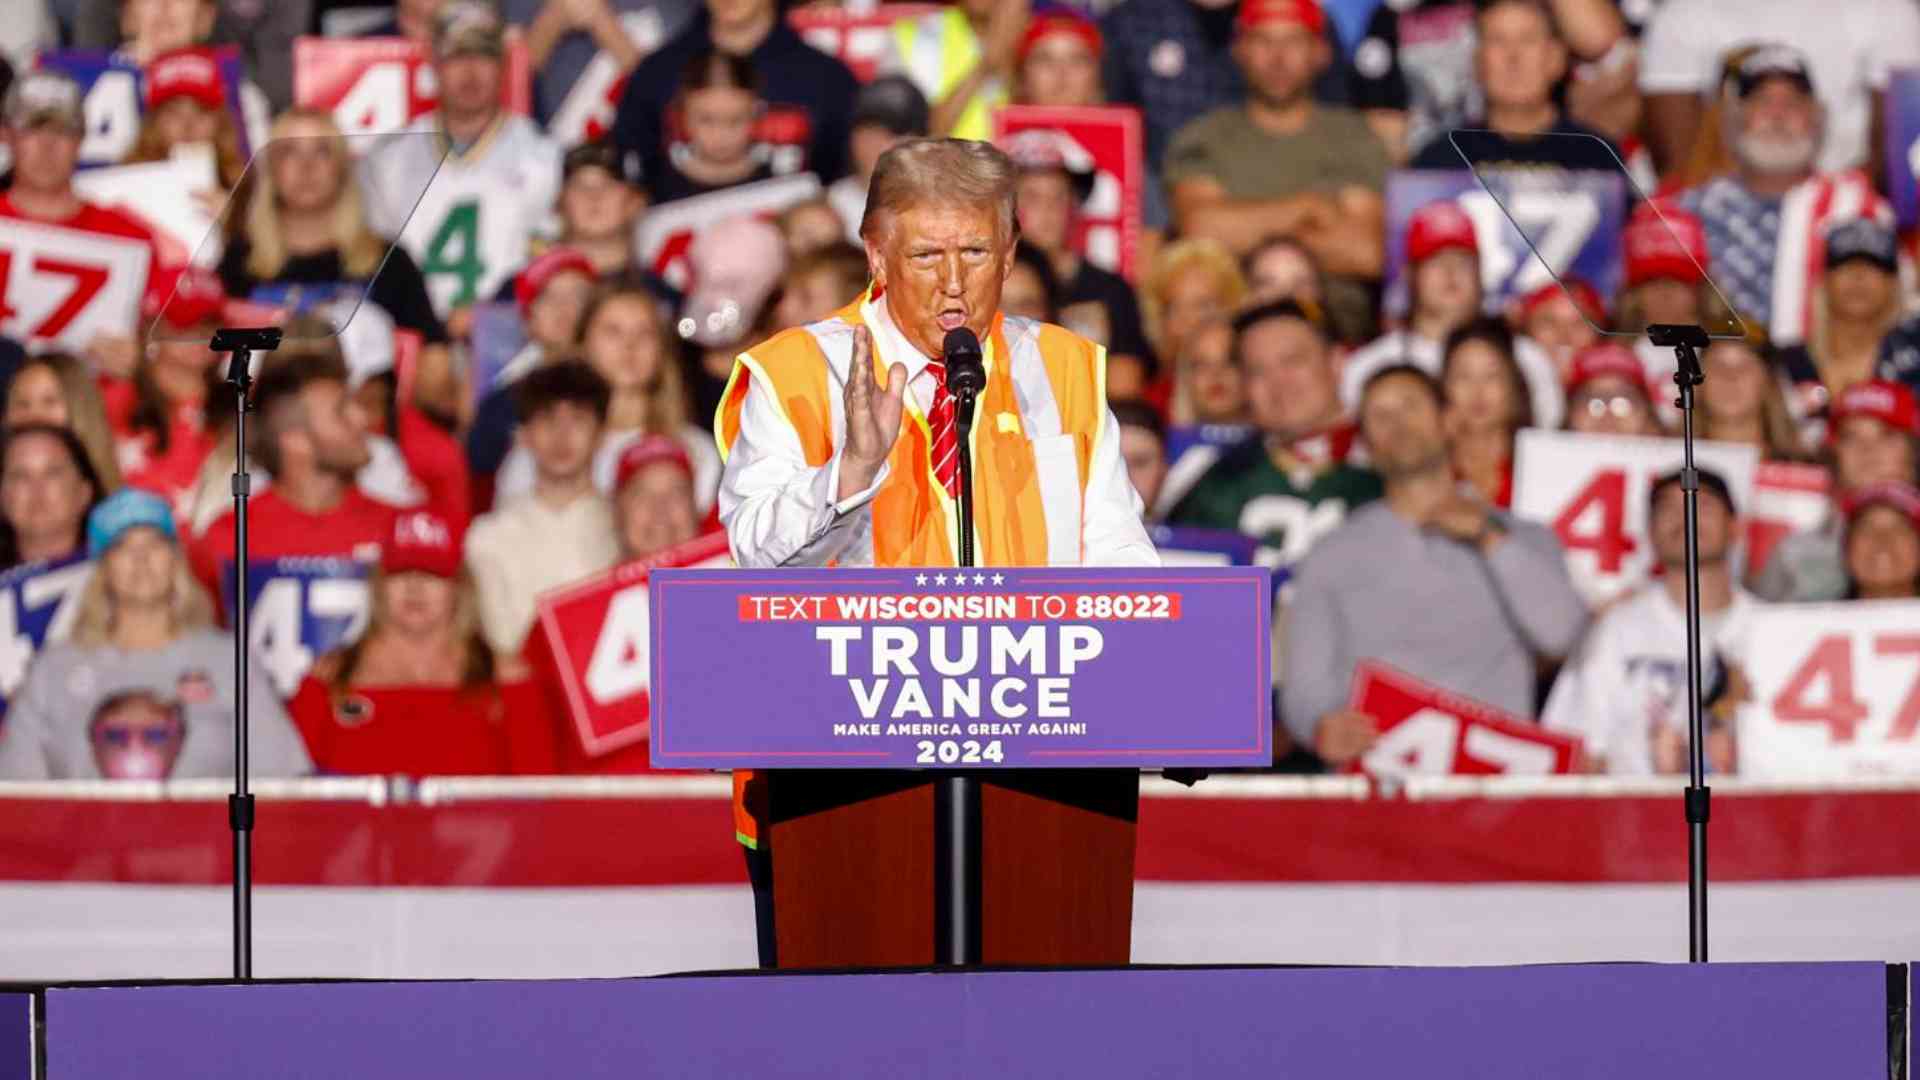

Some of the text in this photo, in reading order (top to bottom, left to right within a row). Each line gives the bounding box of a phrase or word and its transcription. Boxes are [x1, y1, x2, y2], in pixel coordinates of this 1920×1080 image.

[423, 201, 486, 313] 4
[0, 249, 109, 338] 7
[750, 595, 1170, 620] TEXT WISCONSIN TO 88022
[815, 625, 1105, 677] TRUMP
[848, 677, 1071, 719] VANCE
[833, 722, 1087, 736] MAKE AMERICA GREAT AGAIN!
[915, 739, 1004, 764] 2024
